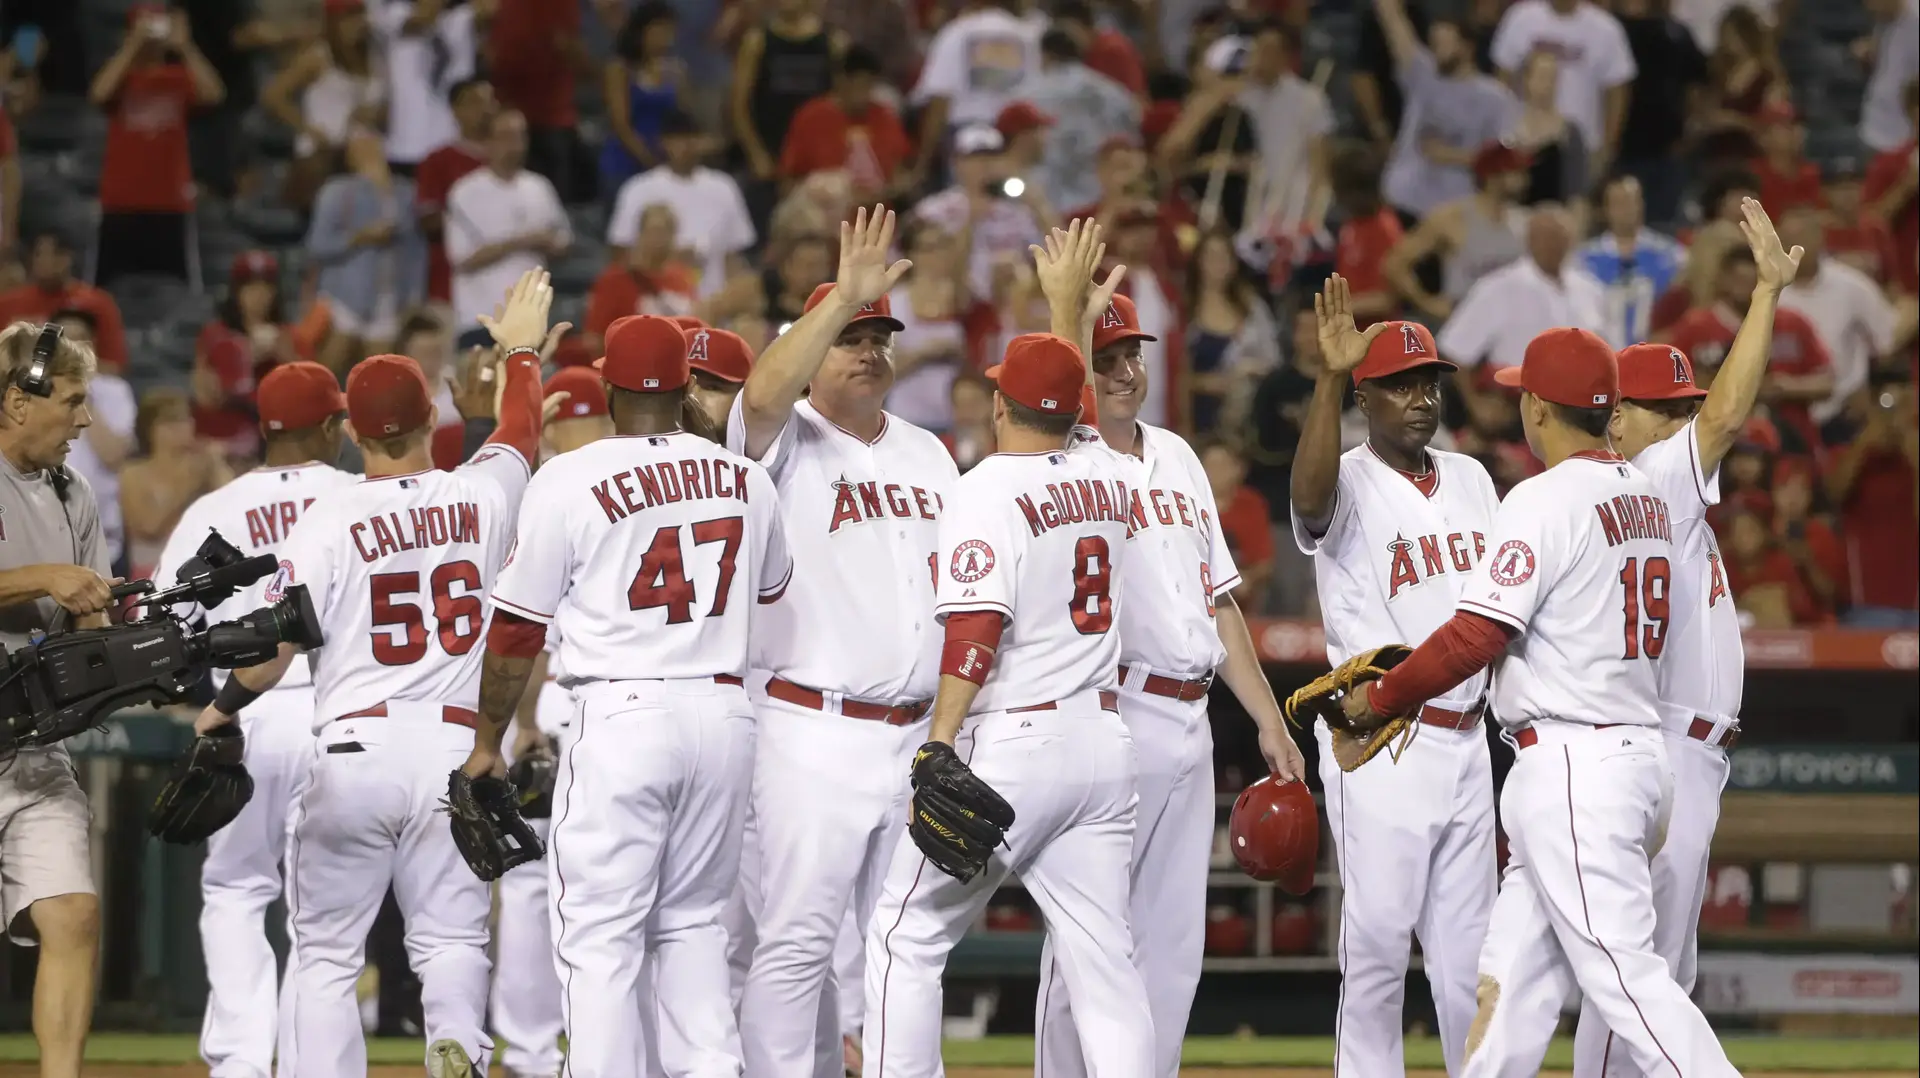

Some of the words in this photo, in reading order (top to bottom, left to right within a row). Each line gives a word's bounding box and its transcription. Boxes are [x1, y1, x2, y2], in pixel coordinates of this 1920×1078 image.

[687, 328, 710, 361] A
[1103, 300, 1125, 329] A
[1400, 322, 1426, 354] A
[1669, 348, 1691, 383] A
[591, 458, 749, 525] KENDRICK
[828, 472, 944, 535] ANGE
[1015, 479, 1128, 539] McDONALD
[1126, 488, 1212, 548] NGELS
[1594, 494, 1673, 547] NAVARRO
[350, 502, 480, 563] CALHOUN
[627, 515, 744, 625] 47
[1068, 535, 1113, 635] 8
[1387, 531, 1487, 601] ANGE
[369, 559, 484, 667] 56
[1619, 556, 1671, 661] 19
[1778, 752, 1898, 784] TOYOTA
